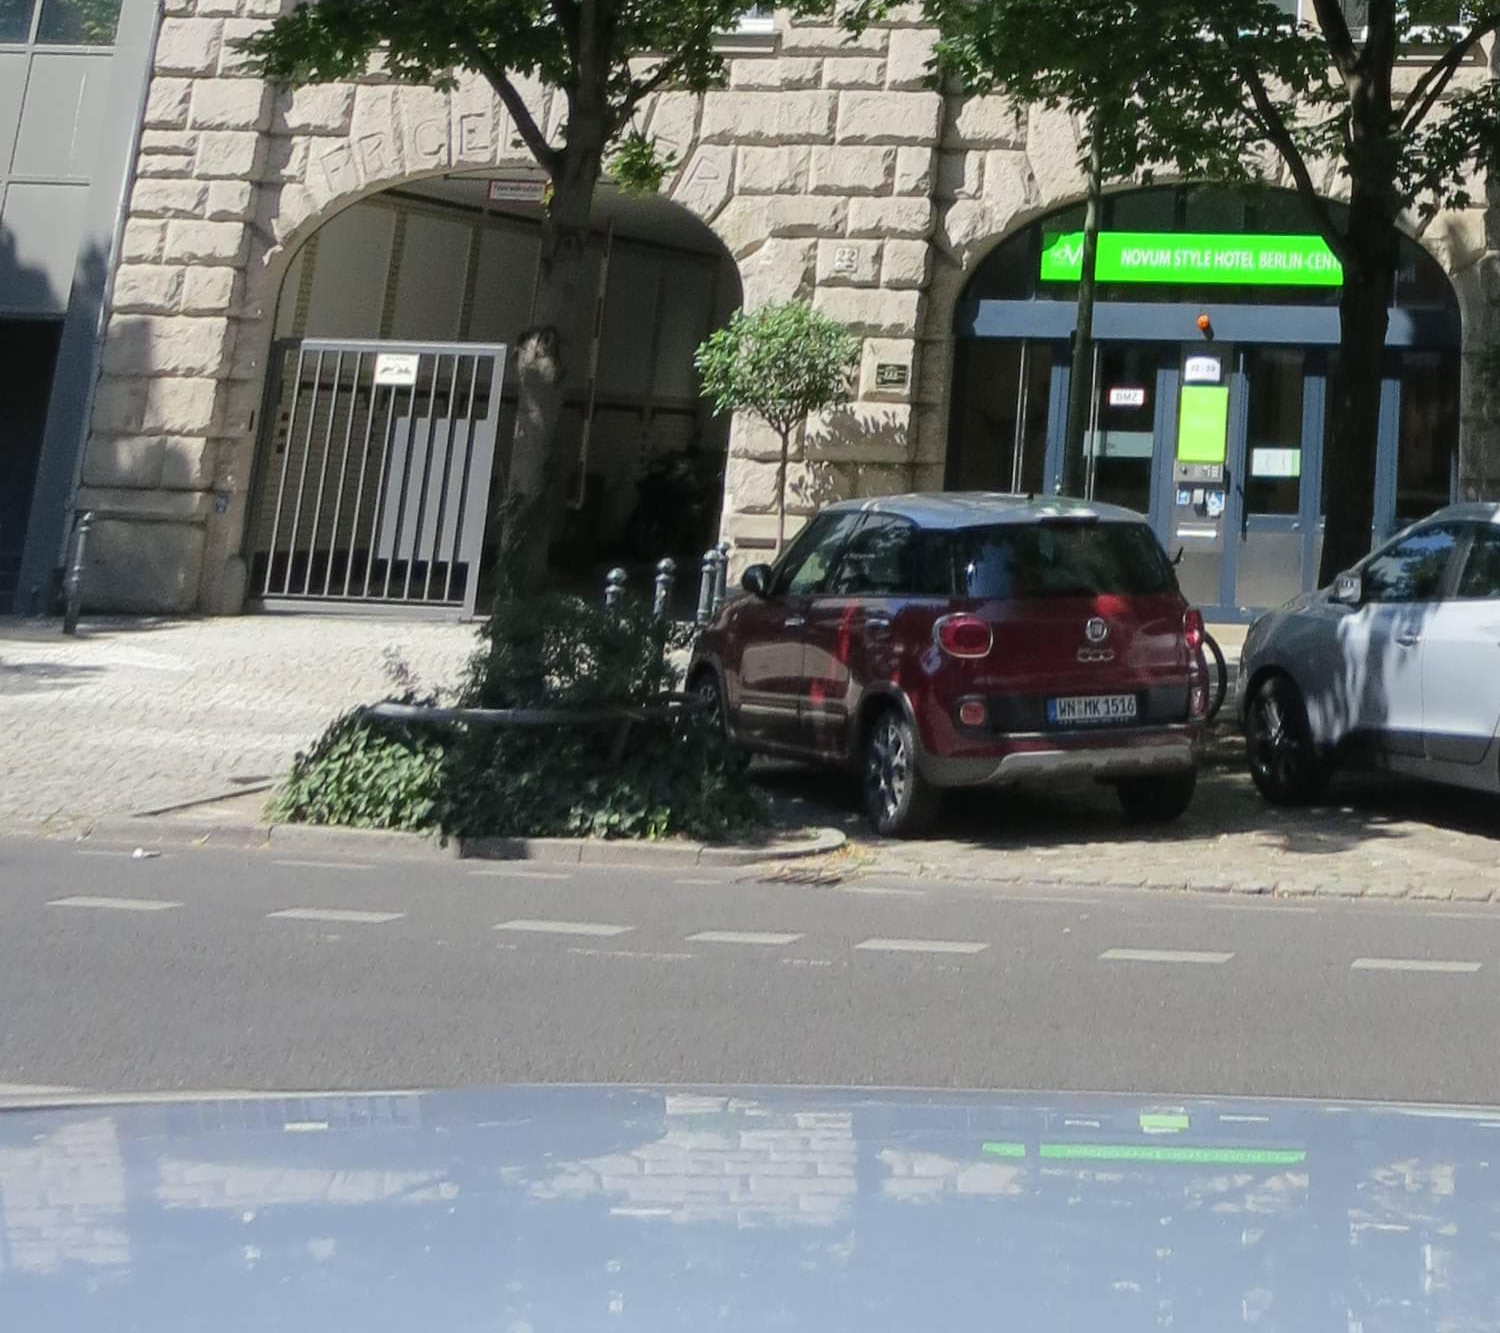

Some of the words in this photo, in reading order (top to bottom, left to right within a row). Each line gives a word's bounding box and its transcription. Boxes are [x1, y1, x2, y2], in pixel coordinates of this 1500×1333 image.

[1120, 249, 1171, 267] NOVUM
[1174, 250, 1211, 268] STYLE
[1214, 251, 1254, 269] HOTEL
[1258, 252, 1341, 270] BERLIN-CENT
[1058, 699, 1076, 717] WN
[1084, 699, 1101, 716] MK
[1104, 697, 1134, 715] 1516
